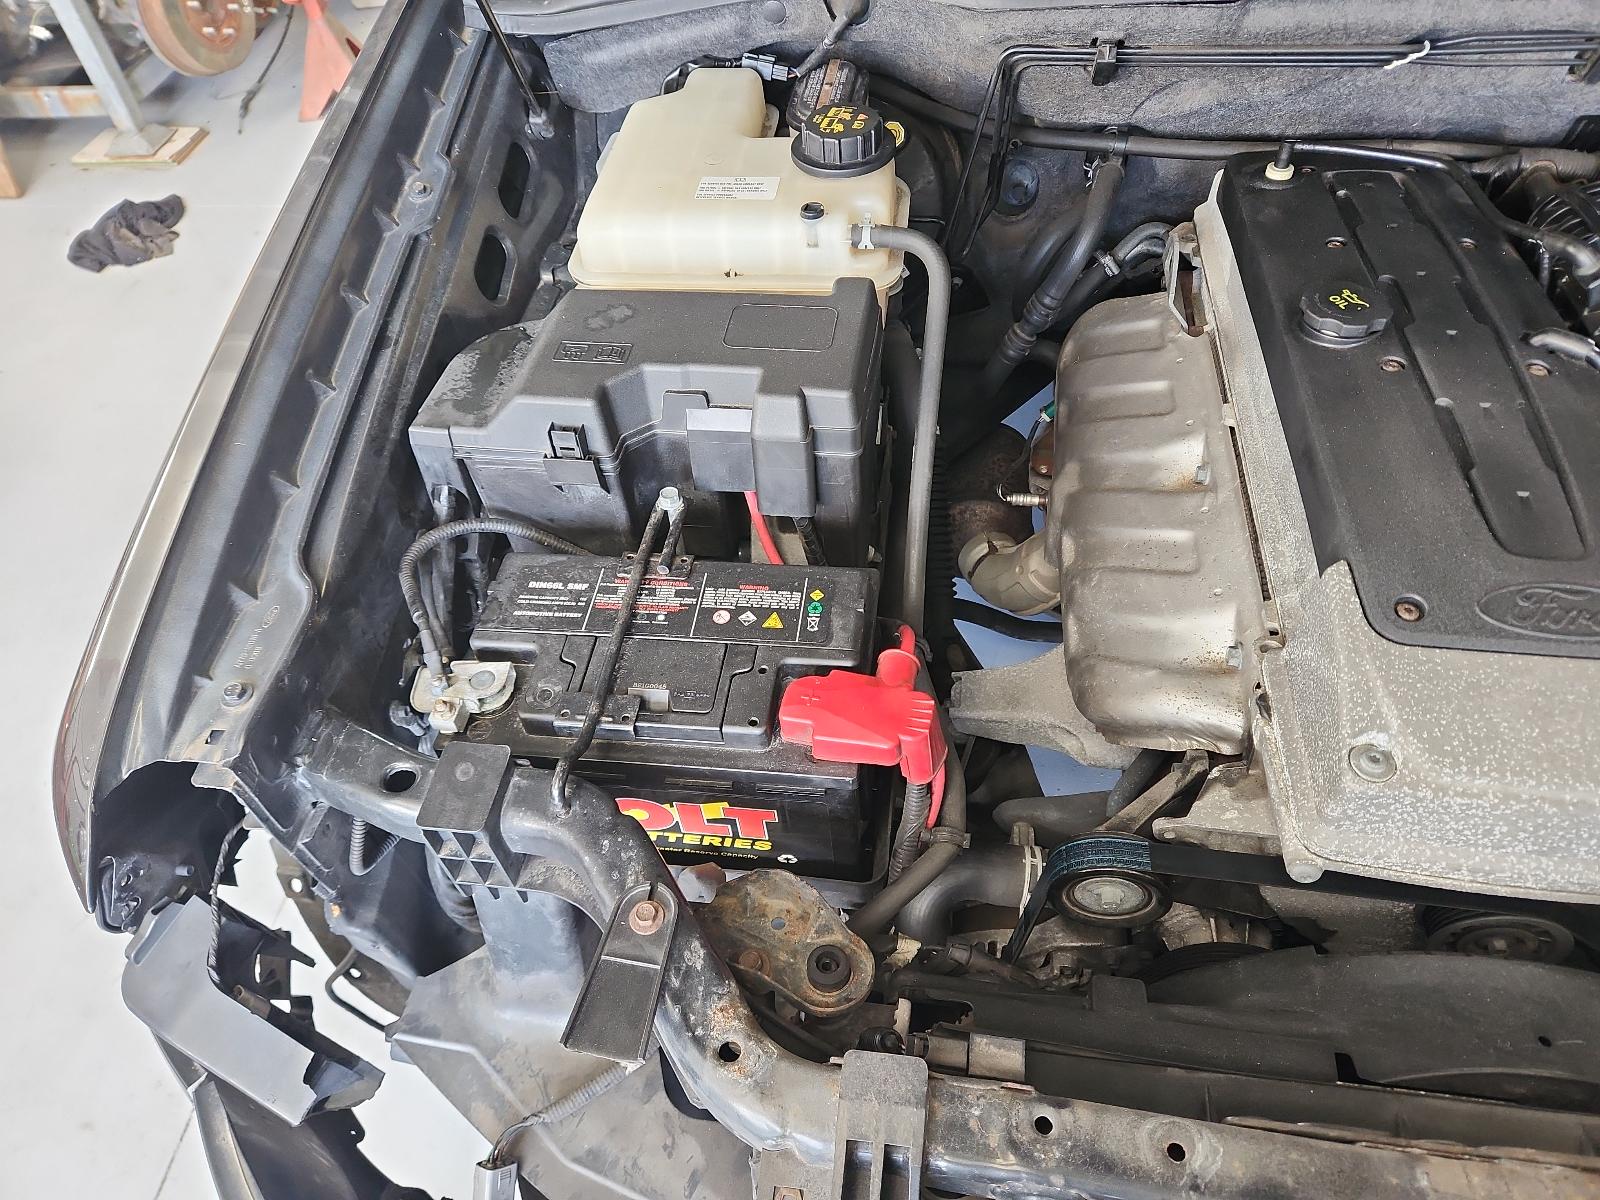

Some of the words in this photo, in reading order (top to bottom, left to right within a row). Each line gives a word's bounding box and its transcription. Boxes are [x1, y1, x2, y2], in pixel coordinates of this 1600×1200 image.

[1329, 295, 1349, 310] OIL
[567, 582, 589, 590] SMF
[1511, 588, 1600, 631] For
[615, 797, 778, 840] OLT
[647, 831, 773, 851] TTERIES
[683, 848, 718, 856] Reserve
[721, 851, 759, 860] Capacity
